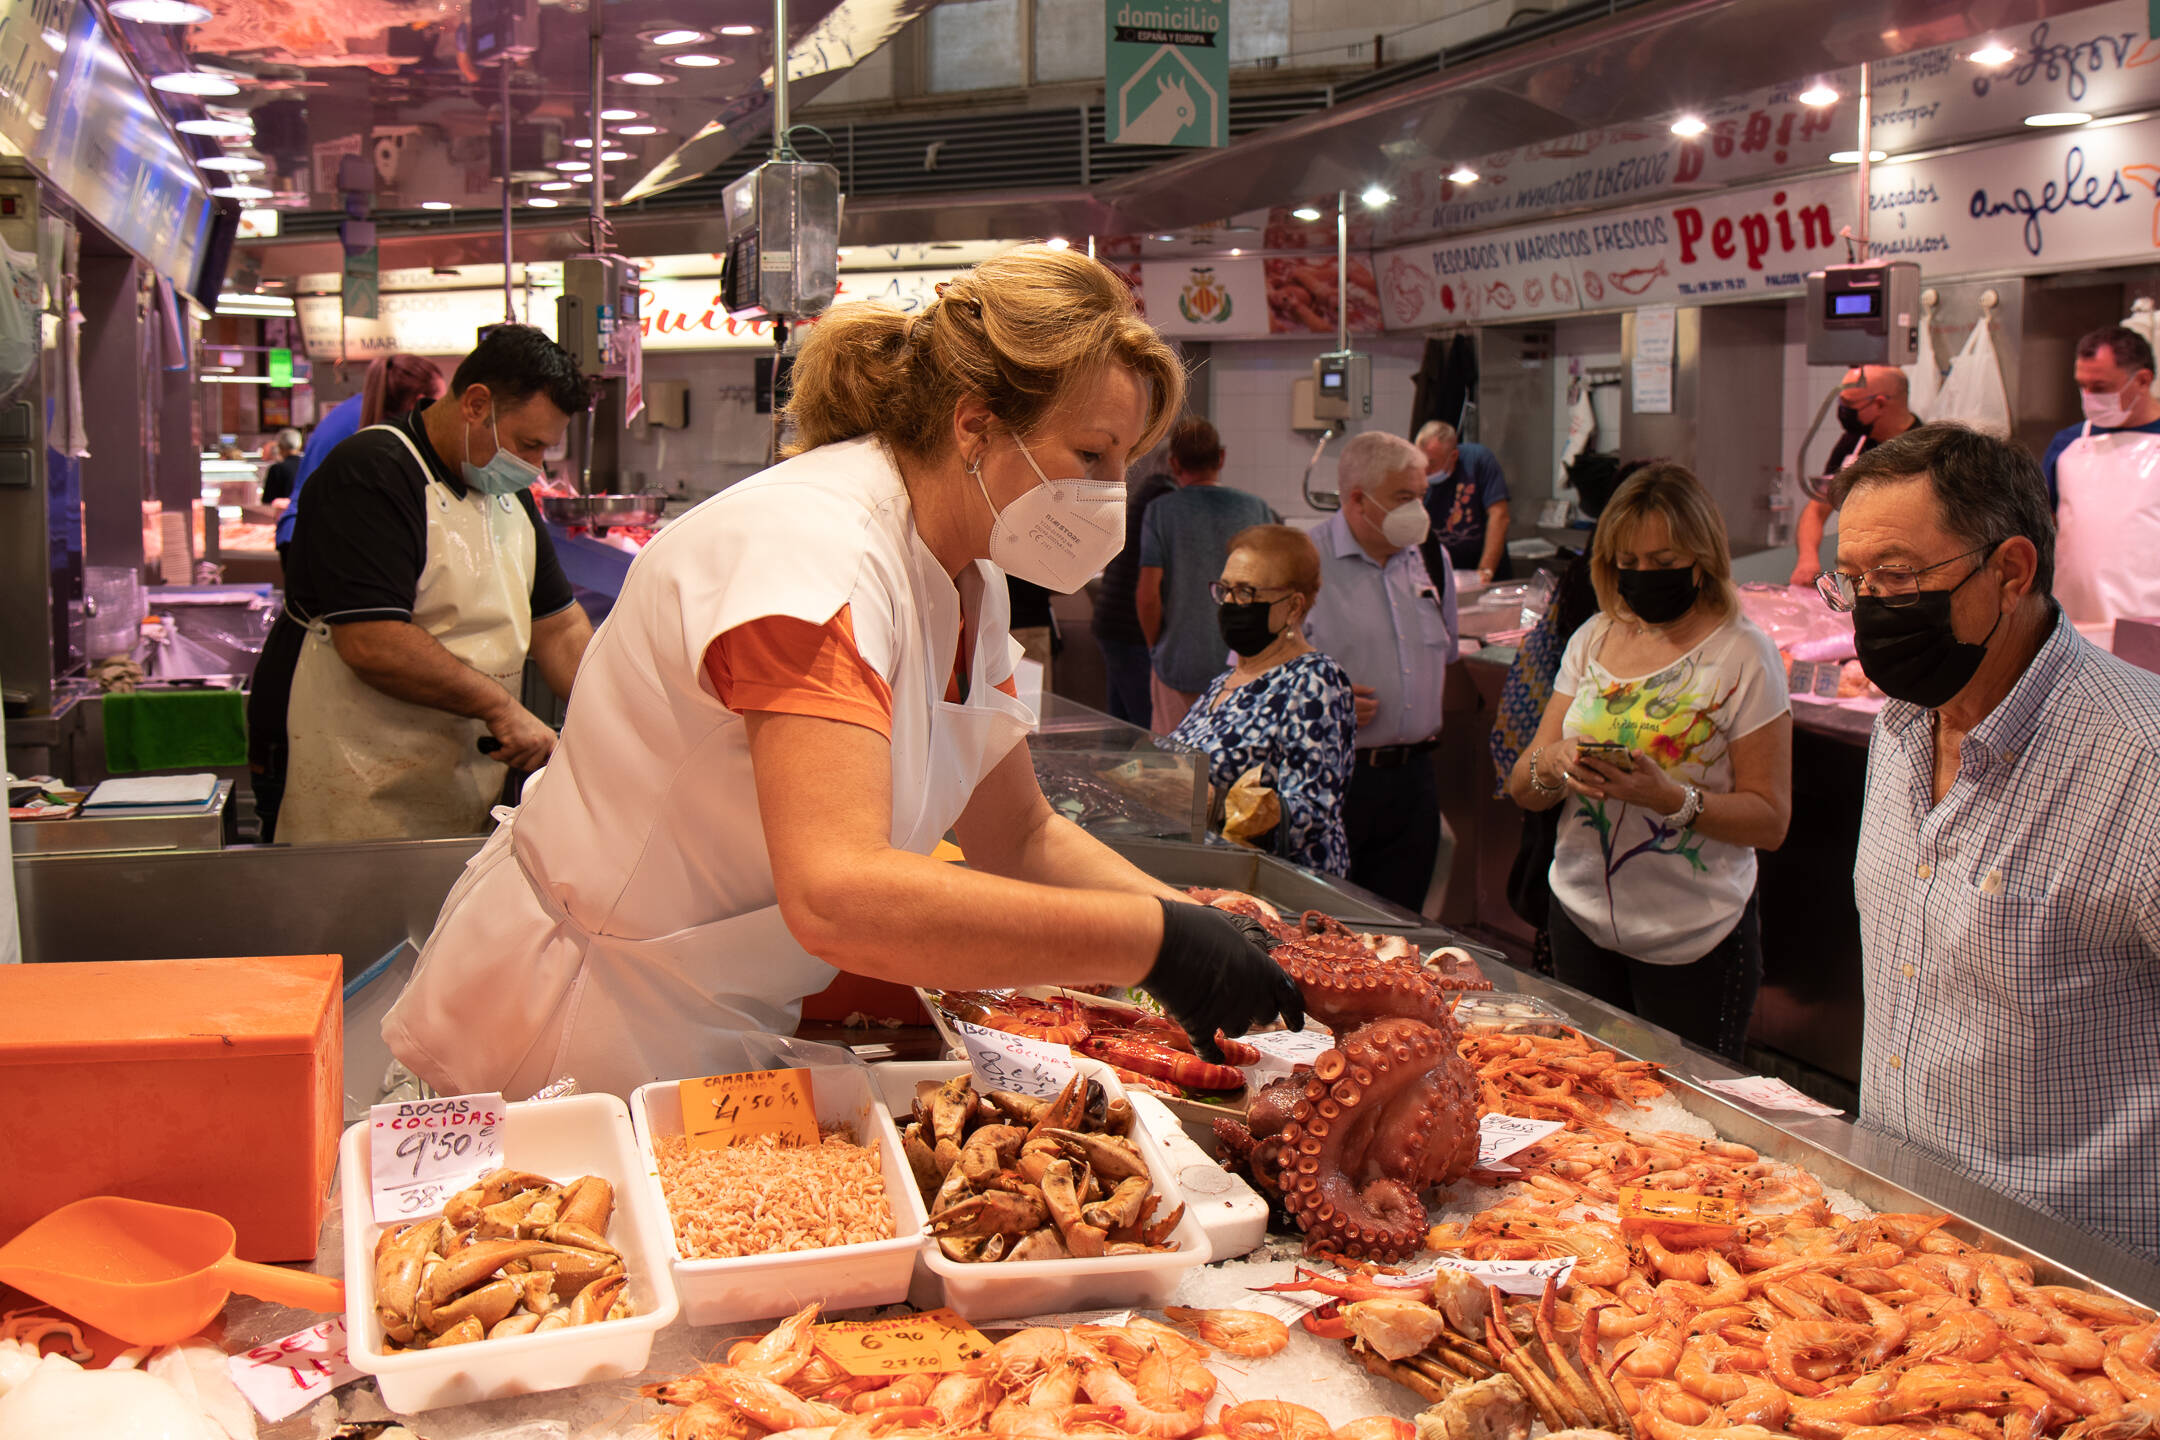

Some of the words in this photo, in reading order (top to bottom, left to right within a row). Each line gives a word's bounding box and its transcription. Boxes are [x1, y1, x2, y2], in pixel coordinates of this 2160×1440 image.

[1117, 3, 1220, 32] domicilio
[1137, 31, 1168, 42] ESPAÑA
[1970, 146, 2132, 256] angeles
[1672, 191, 1836, 271] Pepin
[1432, 243, 1499, 276] PESCADOS
[1499, 242, 1512, 265] Y
[1515, 228, 1591, 264] MARISCOS
[1592, 216, 1669, 254] FRESCOS
[963, 1022, 1024, 1047] BOCAS
[1005, 1044, 1073, 1070] COCIDAS
[397, 1100, 470, 1117] BOCAS
[396, 1131, 472, 1178] 9'50
[860, 1332, 924, 1350] 6'90
